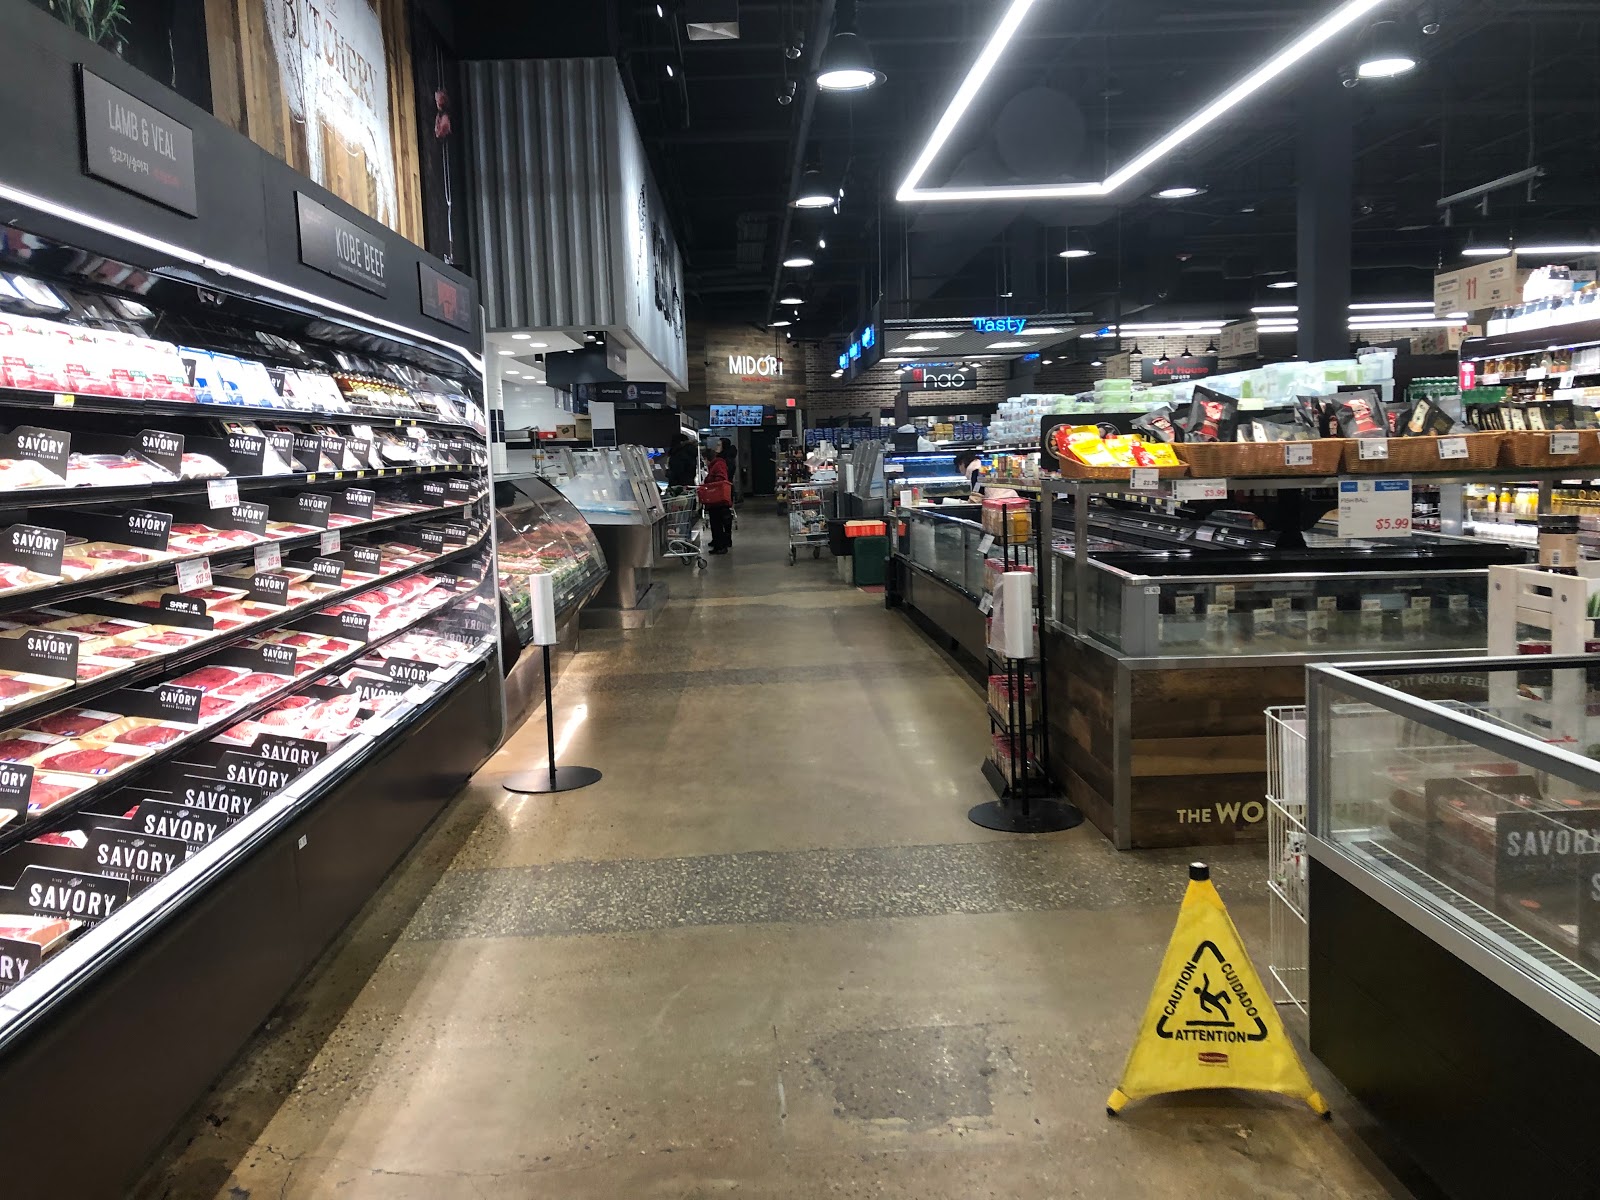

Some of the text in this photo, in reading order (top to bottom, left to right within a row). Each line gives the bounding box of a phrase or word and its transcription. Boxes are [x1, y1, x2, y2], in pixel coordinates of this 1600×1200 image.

[108, 100, 176, 161] LAMB & VEAL
[335, 227, 362, 268] KOBE
[363, 242, 385, 279] BEEF
[1466, 277, 1477, 300] 11
[973, 317, 1027, 336] Tasty
[728, 355, 783, 376] MIDORI
[1153, 366, 1209, 375] Tofu House
[923, 368, 965, 388] hao
[17, 435, 64, 454] SAVORY
[142, 435, 179, 452] SAVORY
[229, 438, 262, 452] SAVORY
[266, 437, 290, 448] VORY
[293, 438, 319, 450] AVORY
[321, 440, 343, 451] AVORY
[346, 440, 368, 451] AVORY
[346, 493, 372, 504] SAVORY
[1204, 489, 1226, 498] $3.99
[299, 497, 328, 510] SAVORY
[231, 507, 264, 521] SAVORY
[128, 516, 167, 532] SAVORY
[1375, 518, 1409, 531] $5.99
[12, 531, 59, 551] SAVORY
[354, 550, 379, 562] SAVORY
[313, 562, 341, 575] SAVORY
[255, 577, 285, 590] SAVORY
[341, 614, 367, 626] SAVORY
[27, 637, 73, 655] SAVORY
[262, 647, 293, 660] SAVORY
[1418, 674, 1458, 686] ENJOY
[1460, 675, 1489, 687] FEEL
[160, 691, 197, 706] SAVORY
[262, 743, 319, 765] SAVORY
[0, 771, 27, 787] ORY
[227, 764, 290, 788] SAVORY
[184, 789, 253, 815] SAVORY
[1177, 809, 1211, 824] THE
[144, 815, 218, 841] SAVORY
[97, 844, 175, 871] SAVORY
[131, 873, 158, 883] DELICIO
[29, 884, 116, 916] SAVORY
[1164, 961, 1198, 1016] CAUTION
[1221, 962, 1258, 1019] CUIDADO
[1175, 1029, 1246, 1043] ATTENTION
